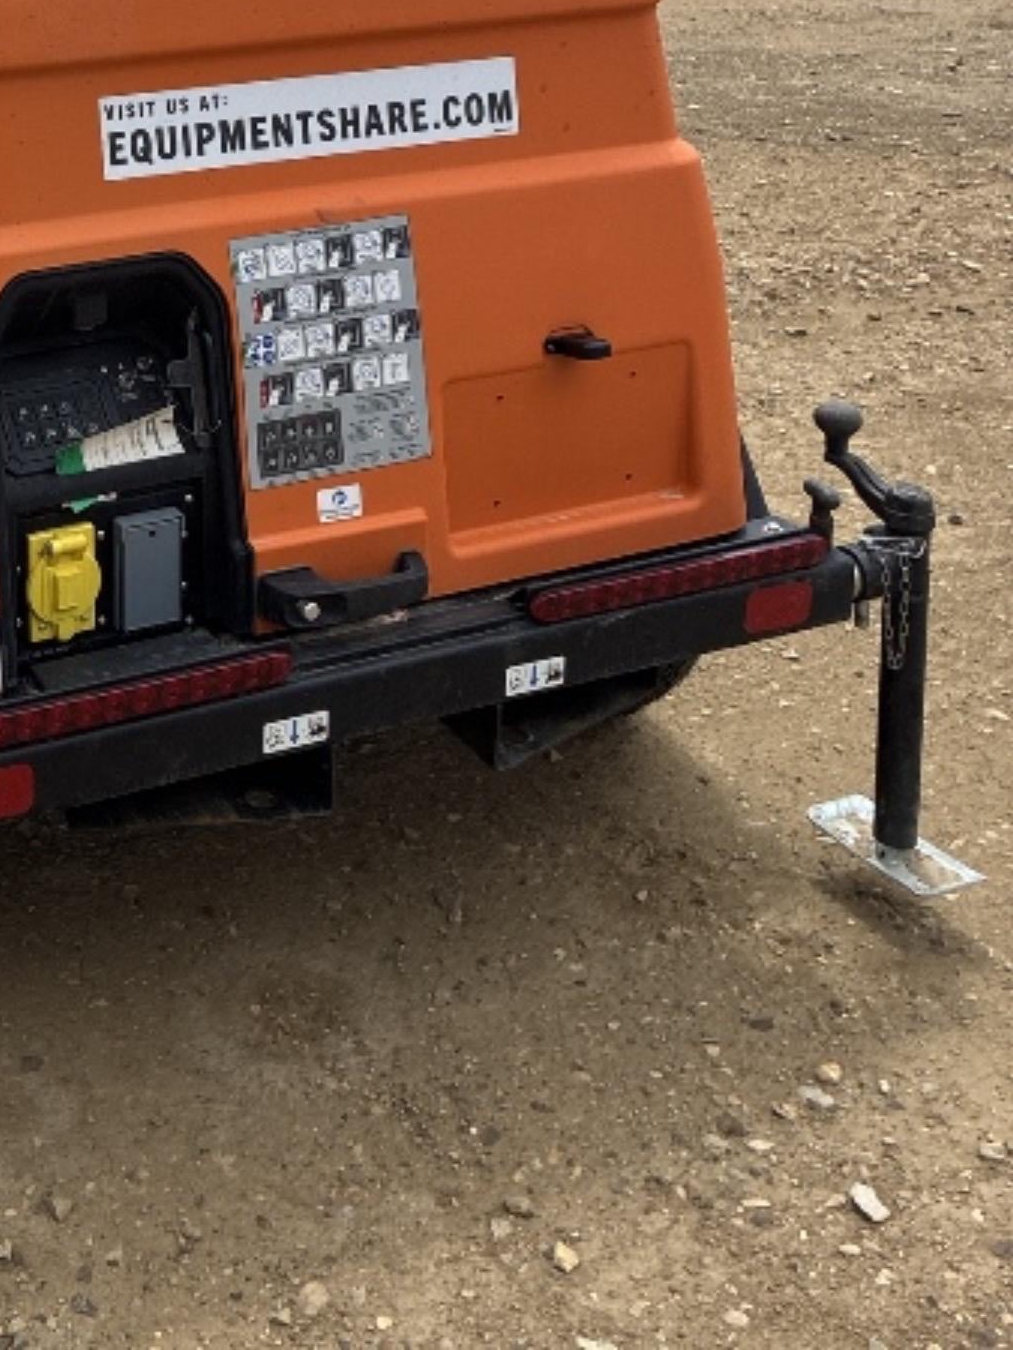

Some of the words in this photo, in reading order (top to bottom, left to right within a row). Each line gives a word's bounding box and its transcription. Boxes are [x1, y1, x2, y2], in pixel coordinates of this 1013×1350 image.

[103, 100, 156, 121] VISIT
[166, 96, 190, 116] US
[198, 92, 229, 111] AT:
[106, 89, 514, 167] EQUIPMENTSHARE.COM
